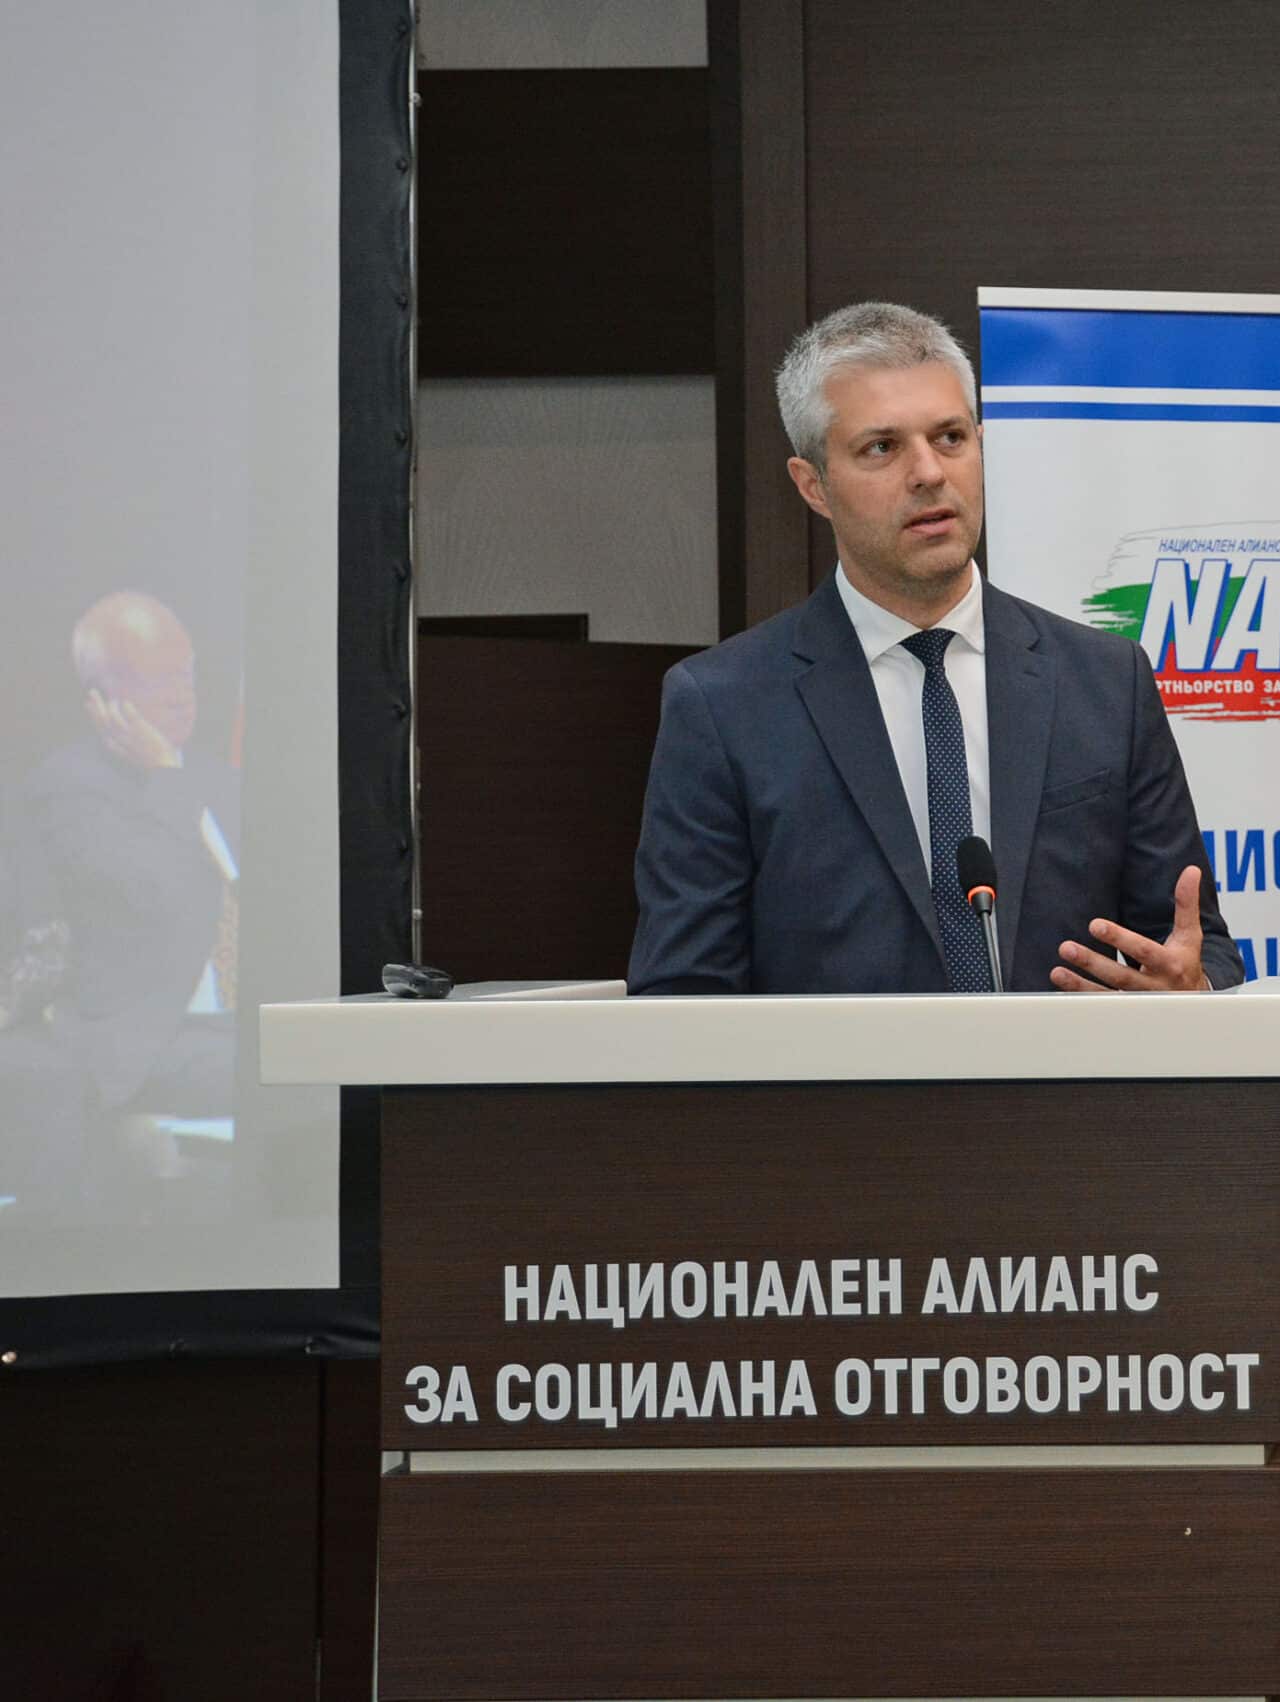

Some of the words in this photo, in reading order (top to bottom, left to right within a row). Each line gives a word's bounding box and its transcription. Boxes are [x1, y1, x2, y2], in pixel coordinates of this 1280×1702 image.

[1159, 538, 1236, 555] НАЦИОНАЛЕН
[504, 1258, 902, 1328] НАЦИОНАЛЕН
[921, 1253, 1159, 1314] АЛИАНС
[404, 1363, 479, 1424] ЗА
[496, 1359, 817, 1429] СОЦИАЛНА
[834, 1353, 1260, 1417] ОТГОВОРНОСТ
